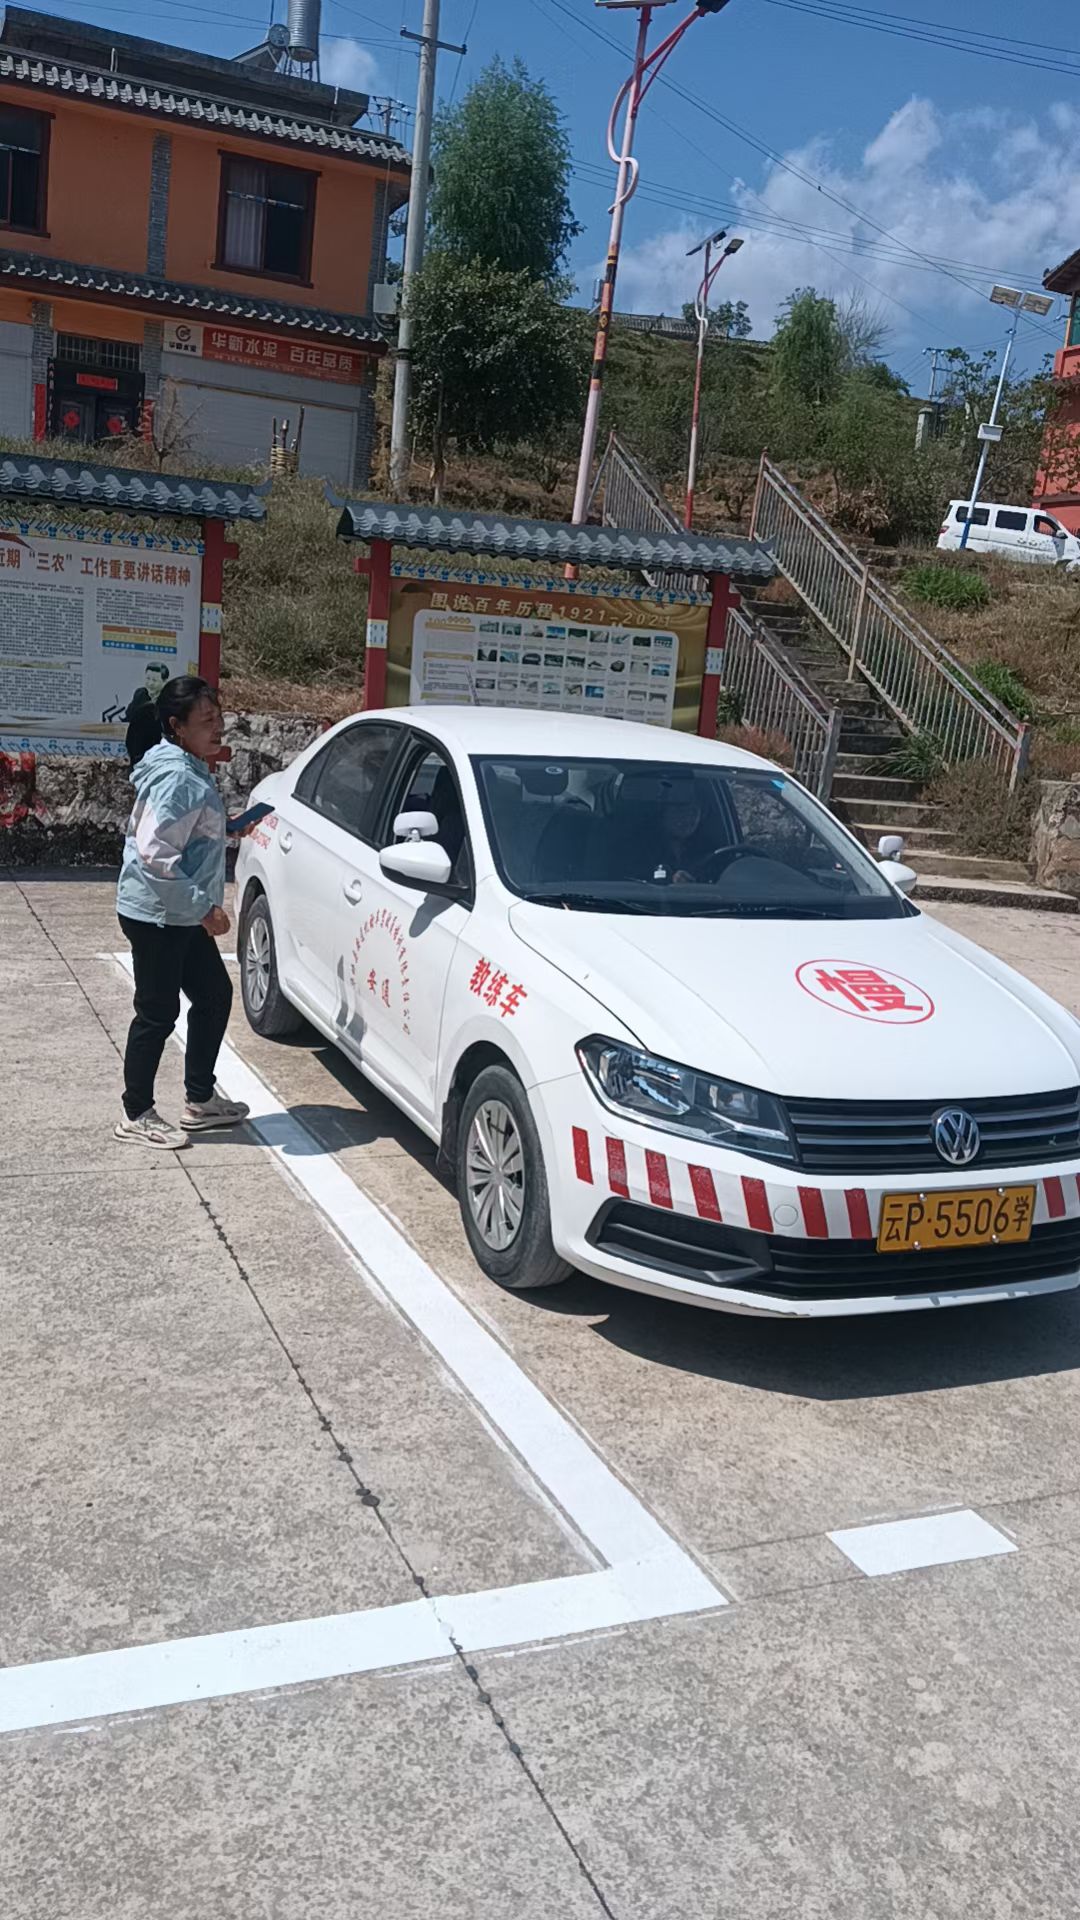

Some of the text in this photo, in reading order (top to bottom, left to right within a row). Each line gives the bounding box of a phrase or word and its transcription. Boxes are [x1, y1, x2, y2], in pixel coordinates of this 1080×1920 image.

[211, 331, 278, 358] 华新水泥
[289, 345, 353, 371] 百年品质
[469, 956, 528, 1017] 教练车
[815, 969, 923, 1012] 慢
